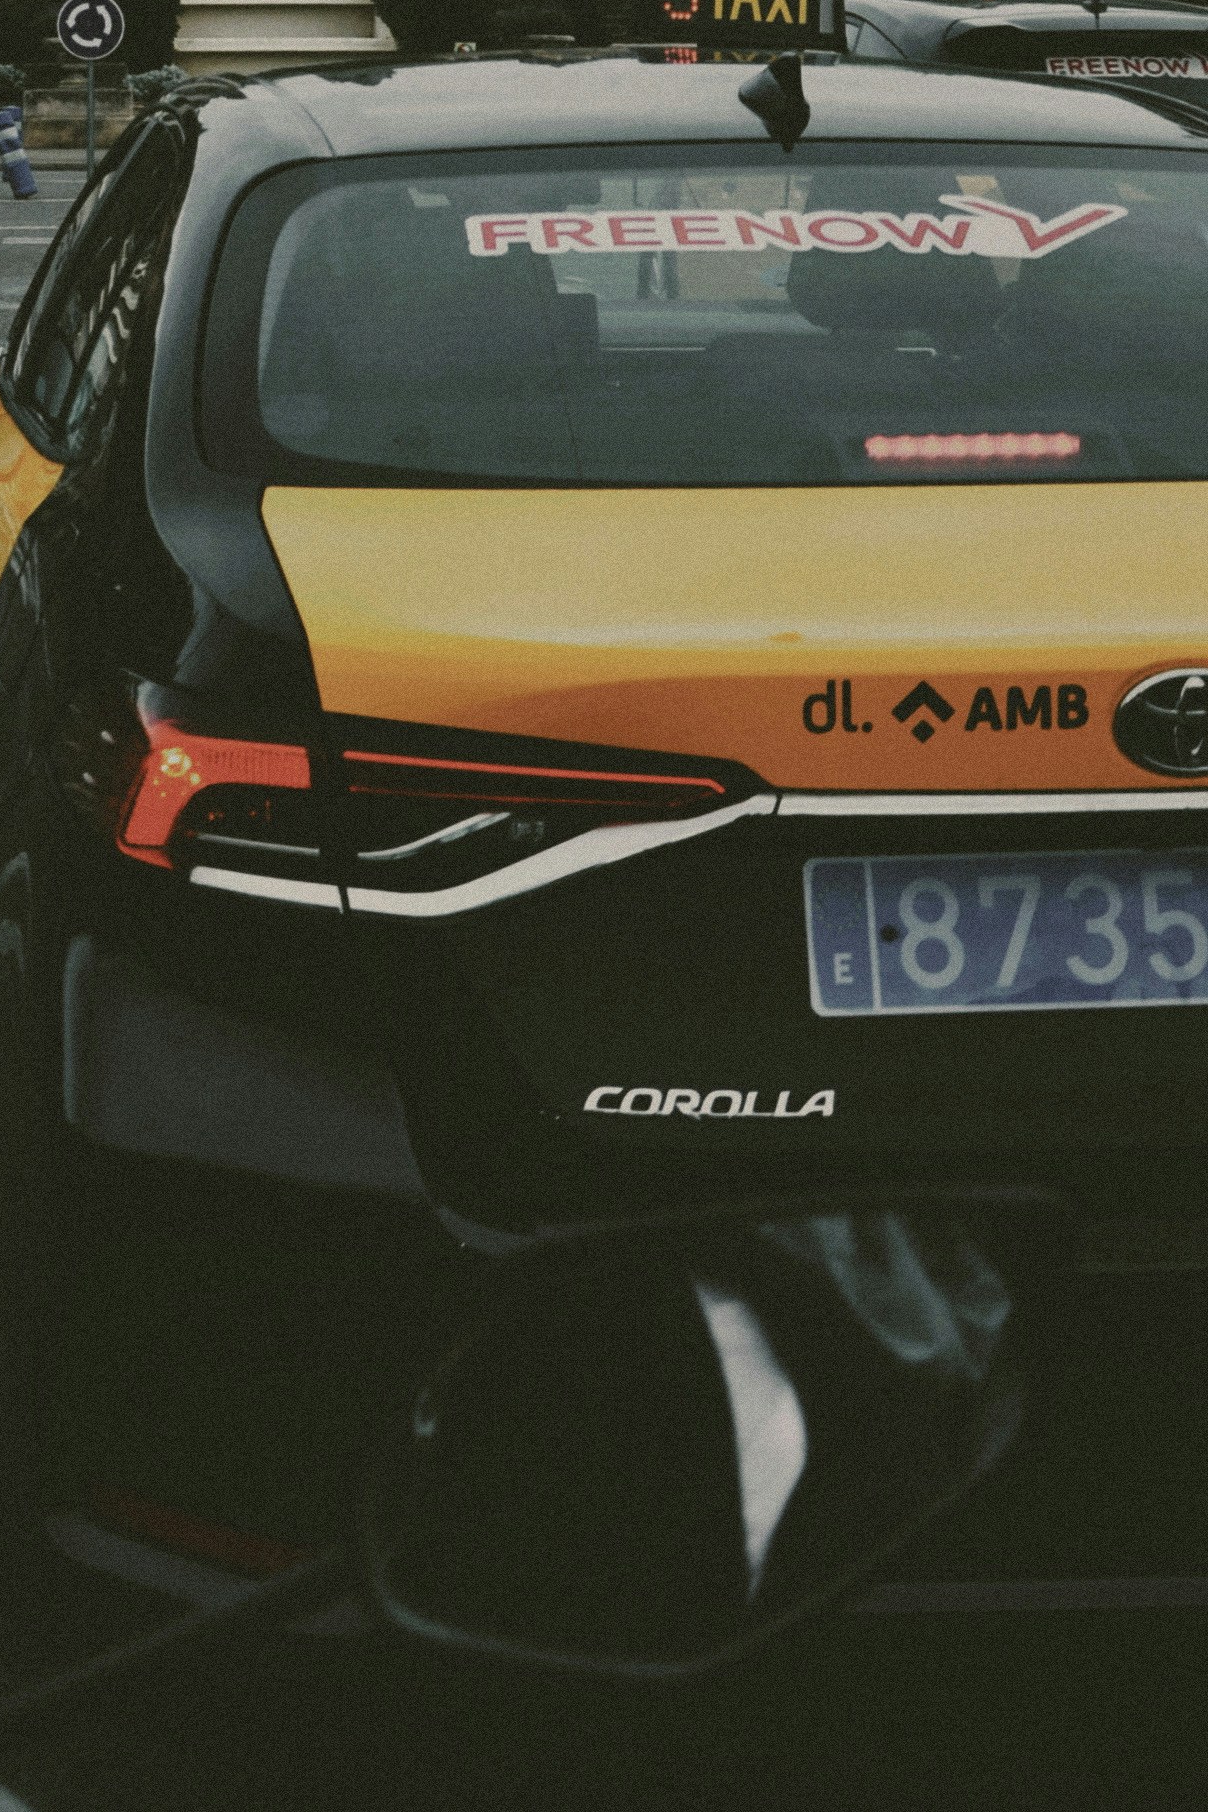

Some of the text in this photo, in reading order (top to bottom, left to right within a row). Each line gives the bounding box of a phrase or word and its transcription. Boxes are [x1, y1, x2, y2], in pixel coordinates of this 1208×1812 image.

[1049, 57, 1190, 76] FREENOW
[479, 211, 971, 251] FREENOW
[801, 679, 1090, 735] dl. AMB
[832, 869, 1208, 990] E 8735
[583, 1085, 835, 1118] COROLLA
